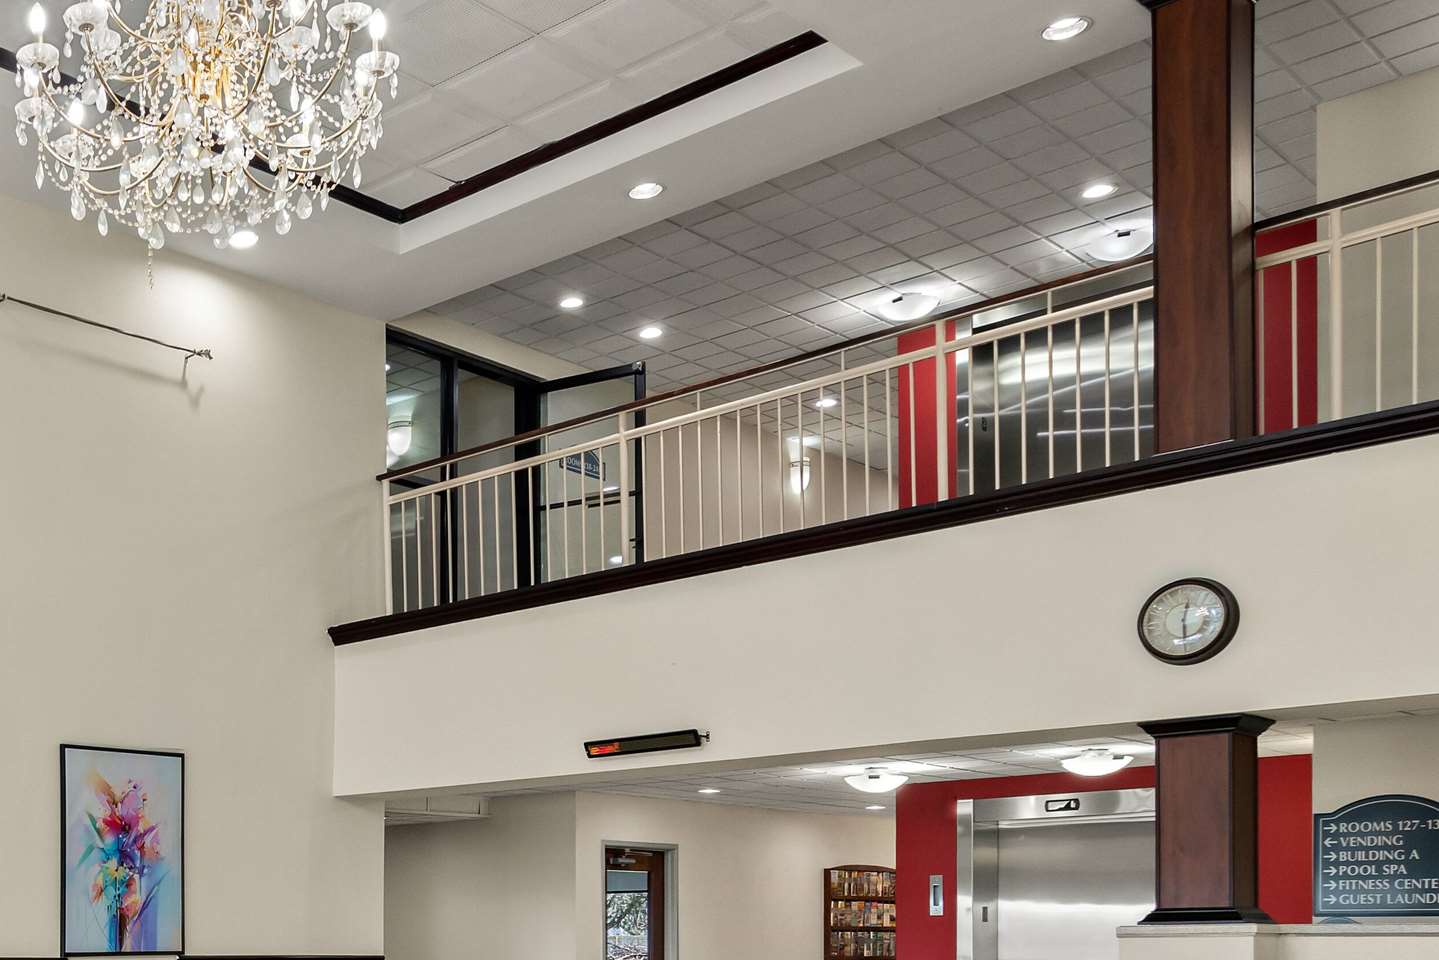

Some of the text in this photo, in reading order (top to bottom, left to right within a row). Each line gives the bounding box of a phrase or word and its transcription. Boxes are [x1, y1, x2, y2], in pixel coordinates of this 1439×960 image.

[1339, 820, 1393, 833] ROOMS
[1340, 834, 1404, 847] VENDING
[1339, 849, 1421, 861] BUILDING A
[1339, 864, 1408, 876] POOL SPA
[1339, 879, 1391, 890] FITNESS
[1339, 893, 1384, 905] GUEST
